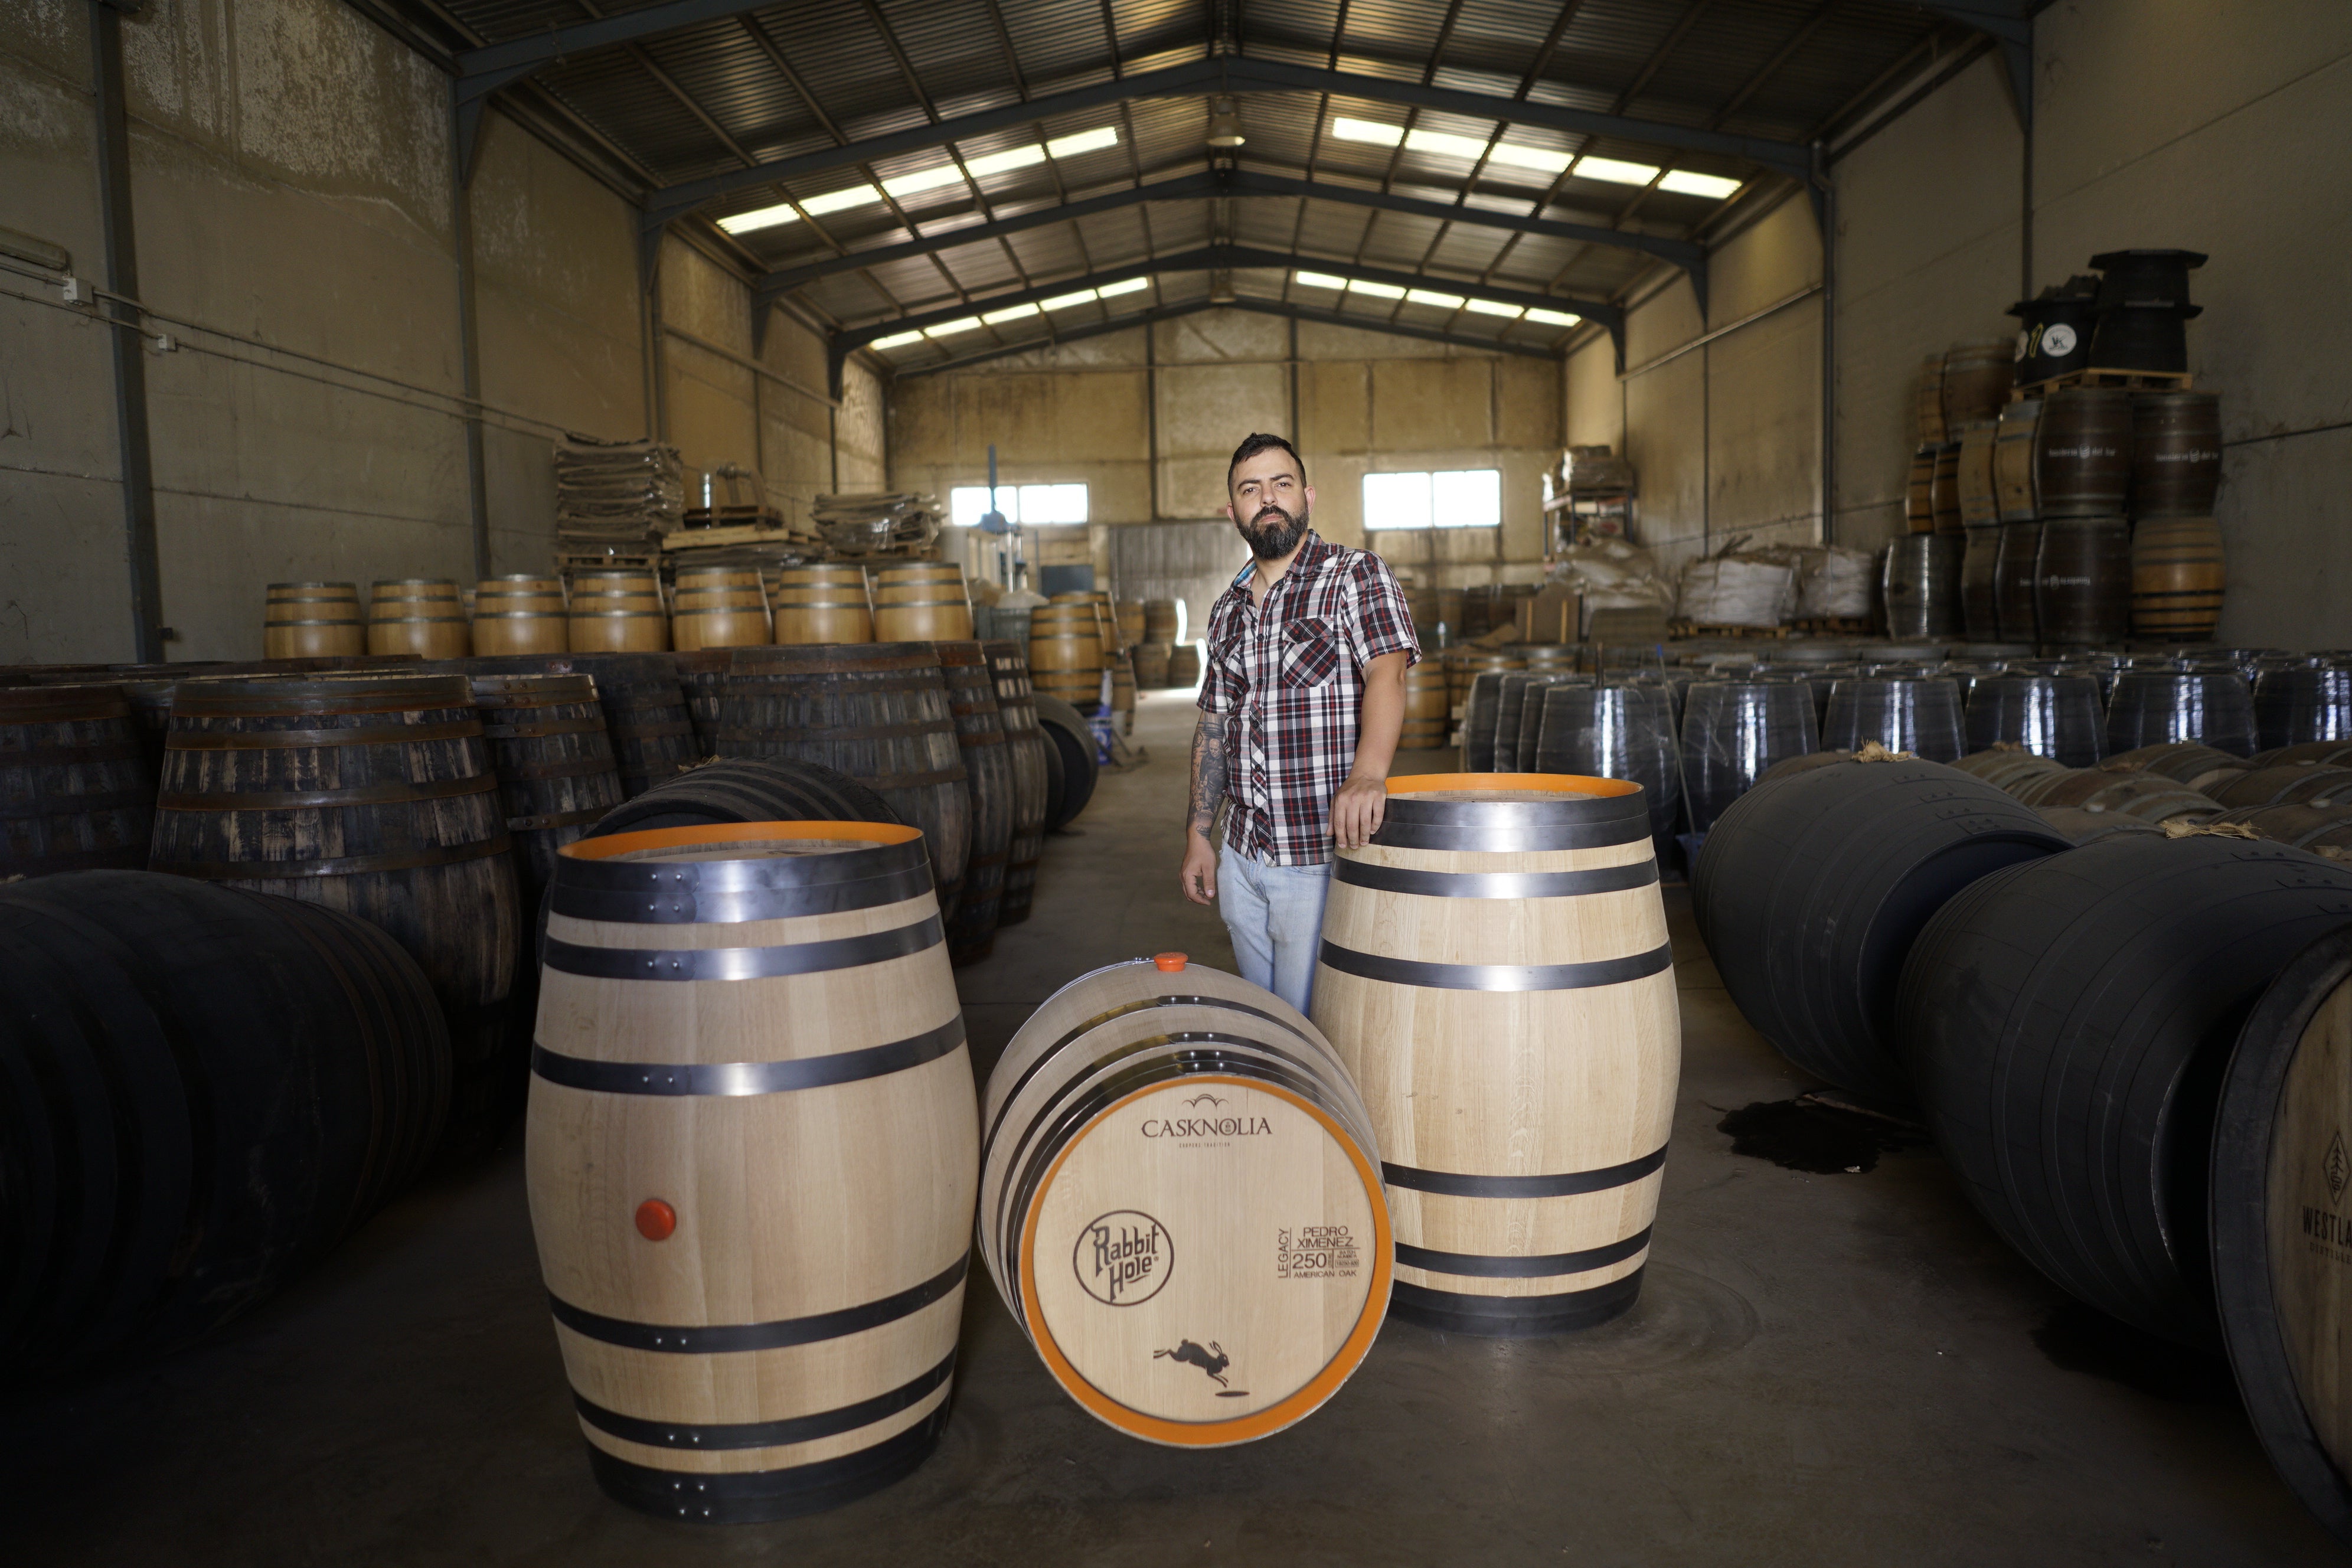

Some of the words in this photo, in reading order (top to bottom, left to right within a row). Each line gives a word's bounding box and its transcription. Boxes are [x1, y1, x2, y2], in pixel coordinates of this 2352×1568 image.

[1141, 1118, 1273, 1138] CASKNOLIA
[1304, 1226, 1348, 1237] PEDRO
[1090, 1222, 1159, 1278] Rabbit
[1297, 1236, 1354, 1249] XIMENEZ
[1278, 1228, 1288, 1278] LEGACY
[1292, 1253, 1327, 1269] 250
[1109, 1256, 1152, 1302] Hole
[1293, 1270, 1335, 1278] AMERICAN
